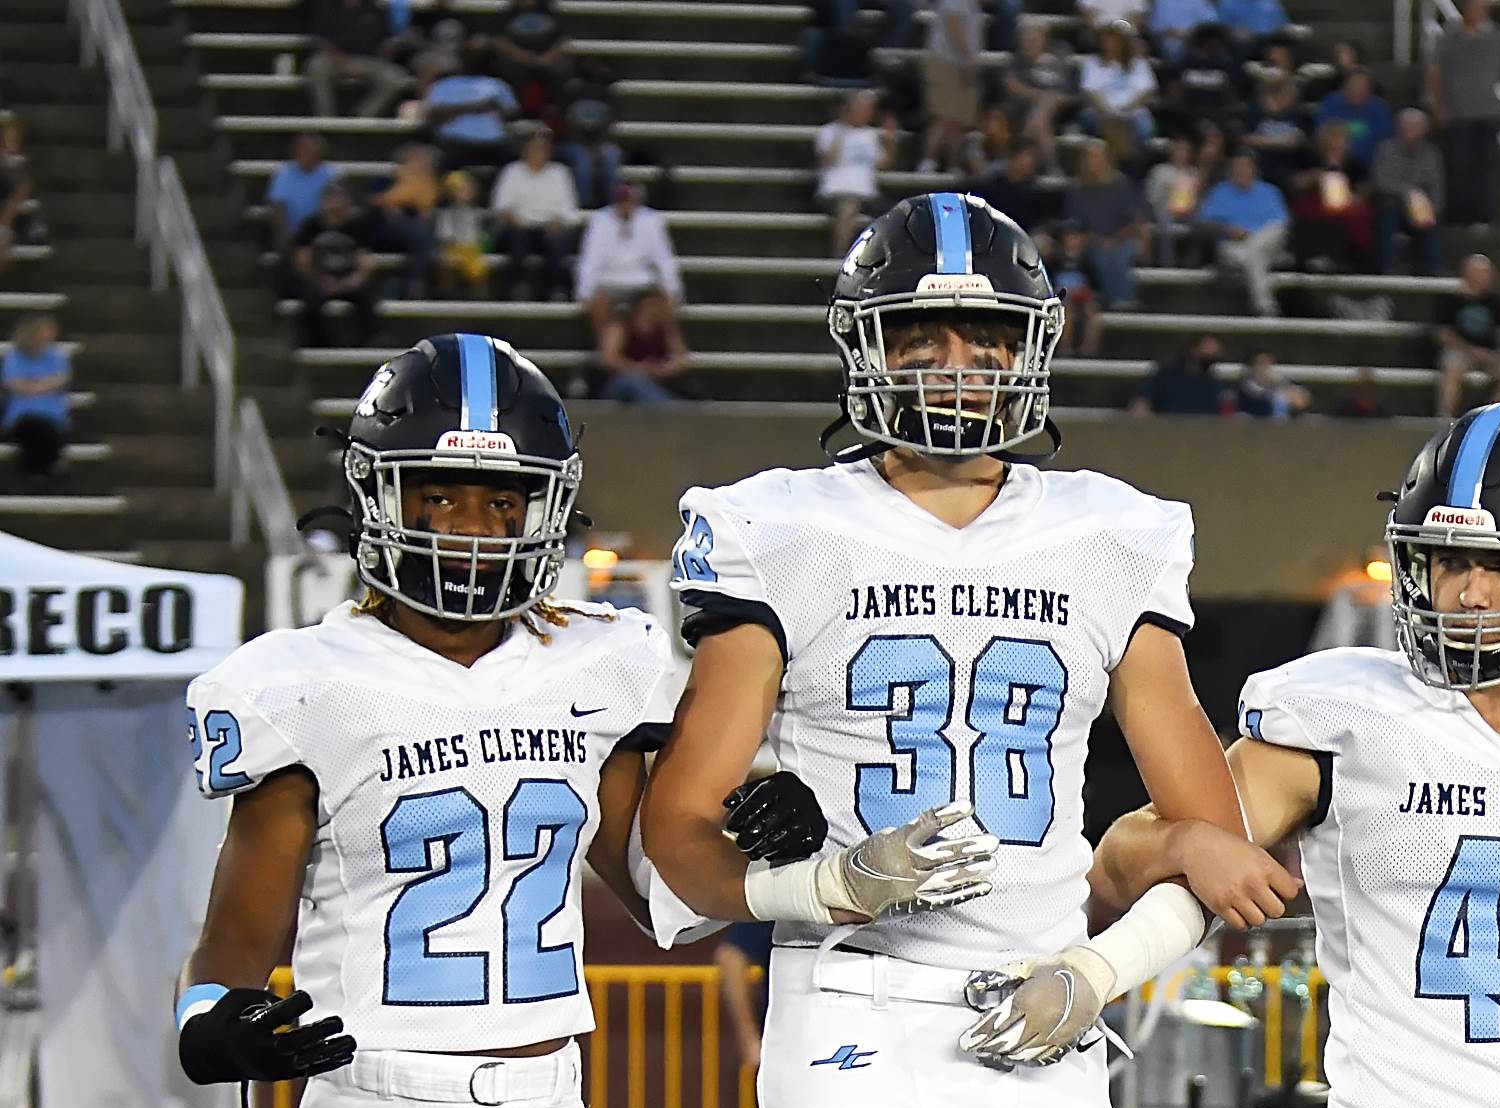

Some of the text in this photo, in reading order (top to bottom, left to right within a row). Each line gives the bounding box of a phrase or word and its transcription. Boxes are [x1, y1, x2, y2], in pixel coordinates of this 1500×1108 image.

[1431, 510, 1485, 526] Riddell
[846, 584, 1069, 626] JAMES CLEMENS
[380, 728, 587, 782] JAMES CLEMENS
[845, 634, 1069, 848] 38
[1400, 782, 1486, 818] JAMES
[380, 778, 588, 1006] 22
